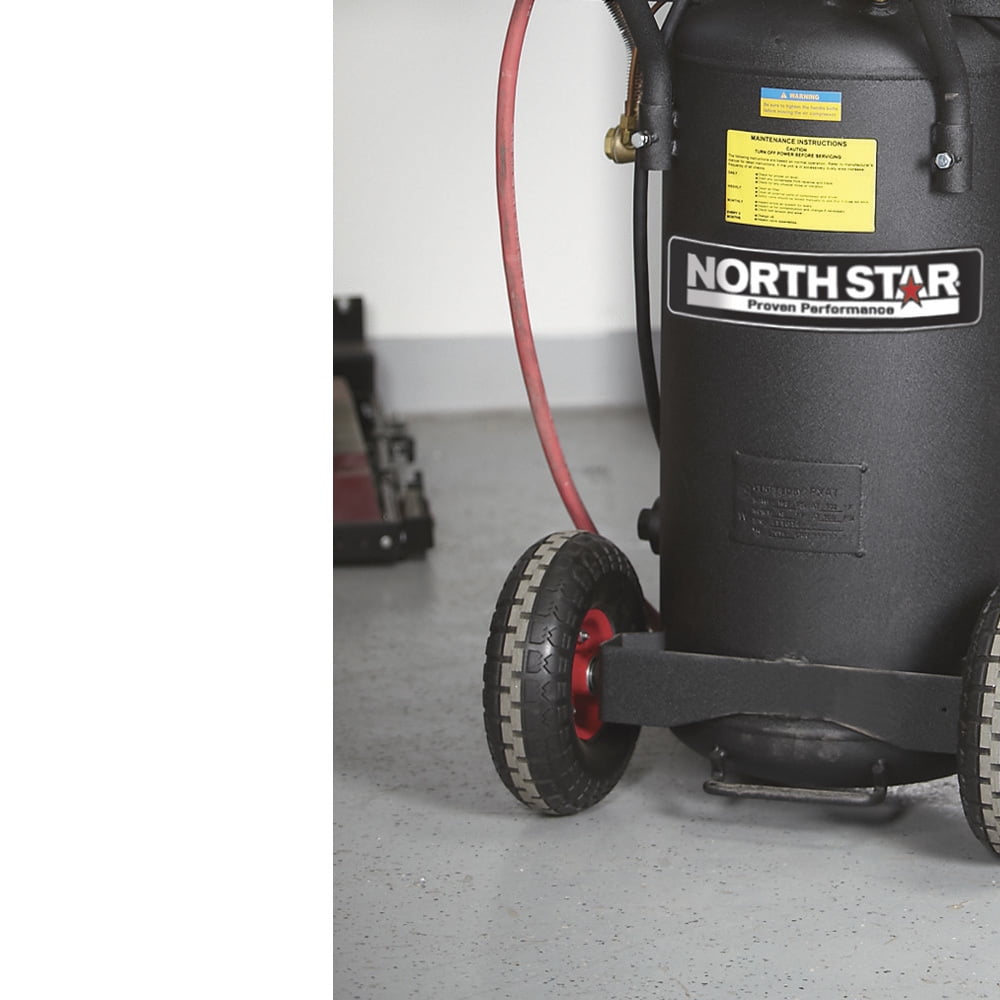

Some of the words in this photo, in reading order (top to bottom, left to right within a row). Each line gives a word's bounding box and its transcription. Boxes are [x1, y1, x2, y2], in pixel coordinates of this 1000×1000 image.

[751, 135, 796, 144] MAINTENANCE
[796, 139, 848, 147] INSTRUCTIONS
[687, 252, 838, 299] NORTH
[845, 263, 960, 300] STAR
[747, 299, 797, 313] Proven
[800, 302, 895, 316] Performance
